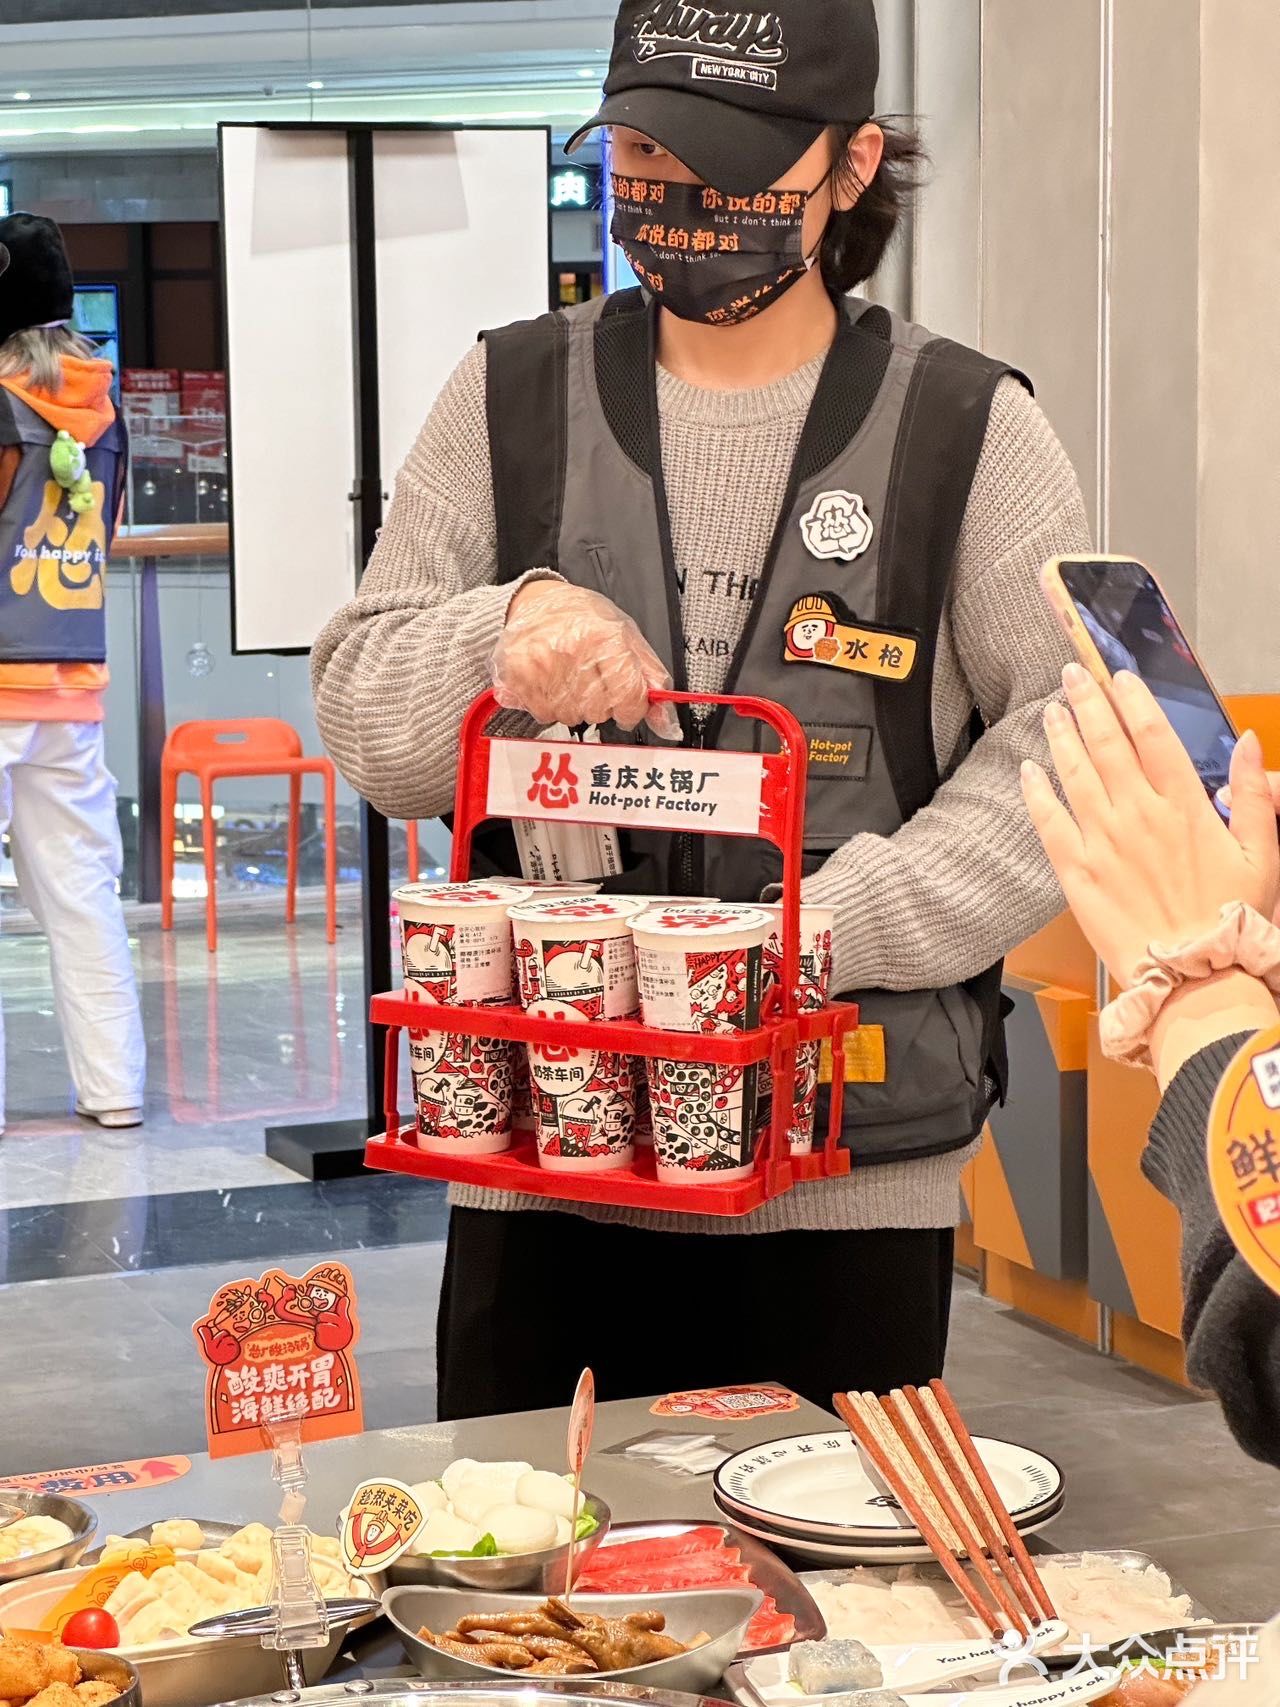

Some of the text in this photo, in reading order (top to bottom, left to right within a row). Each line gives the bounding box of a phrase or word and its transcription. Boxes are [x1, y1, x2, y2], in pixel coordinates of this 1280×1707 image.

[700, 64, 769, 83] NEW YORK CITY
[702, 187, 808, 214] 你说的都
[742, 216, 766, 225] don't
[771, 218, 791, 226] think
[14, 545, 38, 560] You
[40, 546, 92, 564] happy
[844, 638, 904, 668] 水枪
[808, 751, 849, 765] Factory
[810, 739, 852, 753] Hot-pot
[527, 752, 579, 809] 怂
[590, 763, 720, 794] 重庆火锅厂
[588, 791, 718, 816] Hot-pot Factory
[533, 1063, 585, 1083] 奶茶车间
[224, 1353, 335, 1396] 酸爽开胃
[231, 1387, 341, 1424] 海鲜绝配
[936, 1655, 966, 1664] You
[1036, 1626, 1055, 1638] ok
[1070, 1683, 1083, 1694] is
[1086, 1675, 1106, 1686] ok
